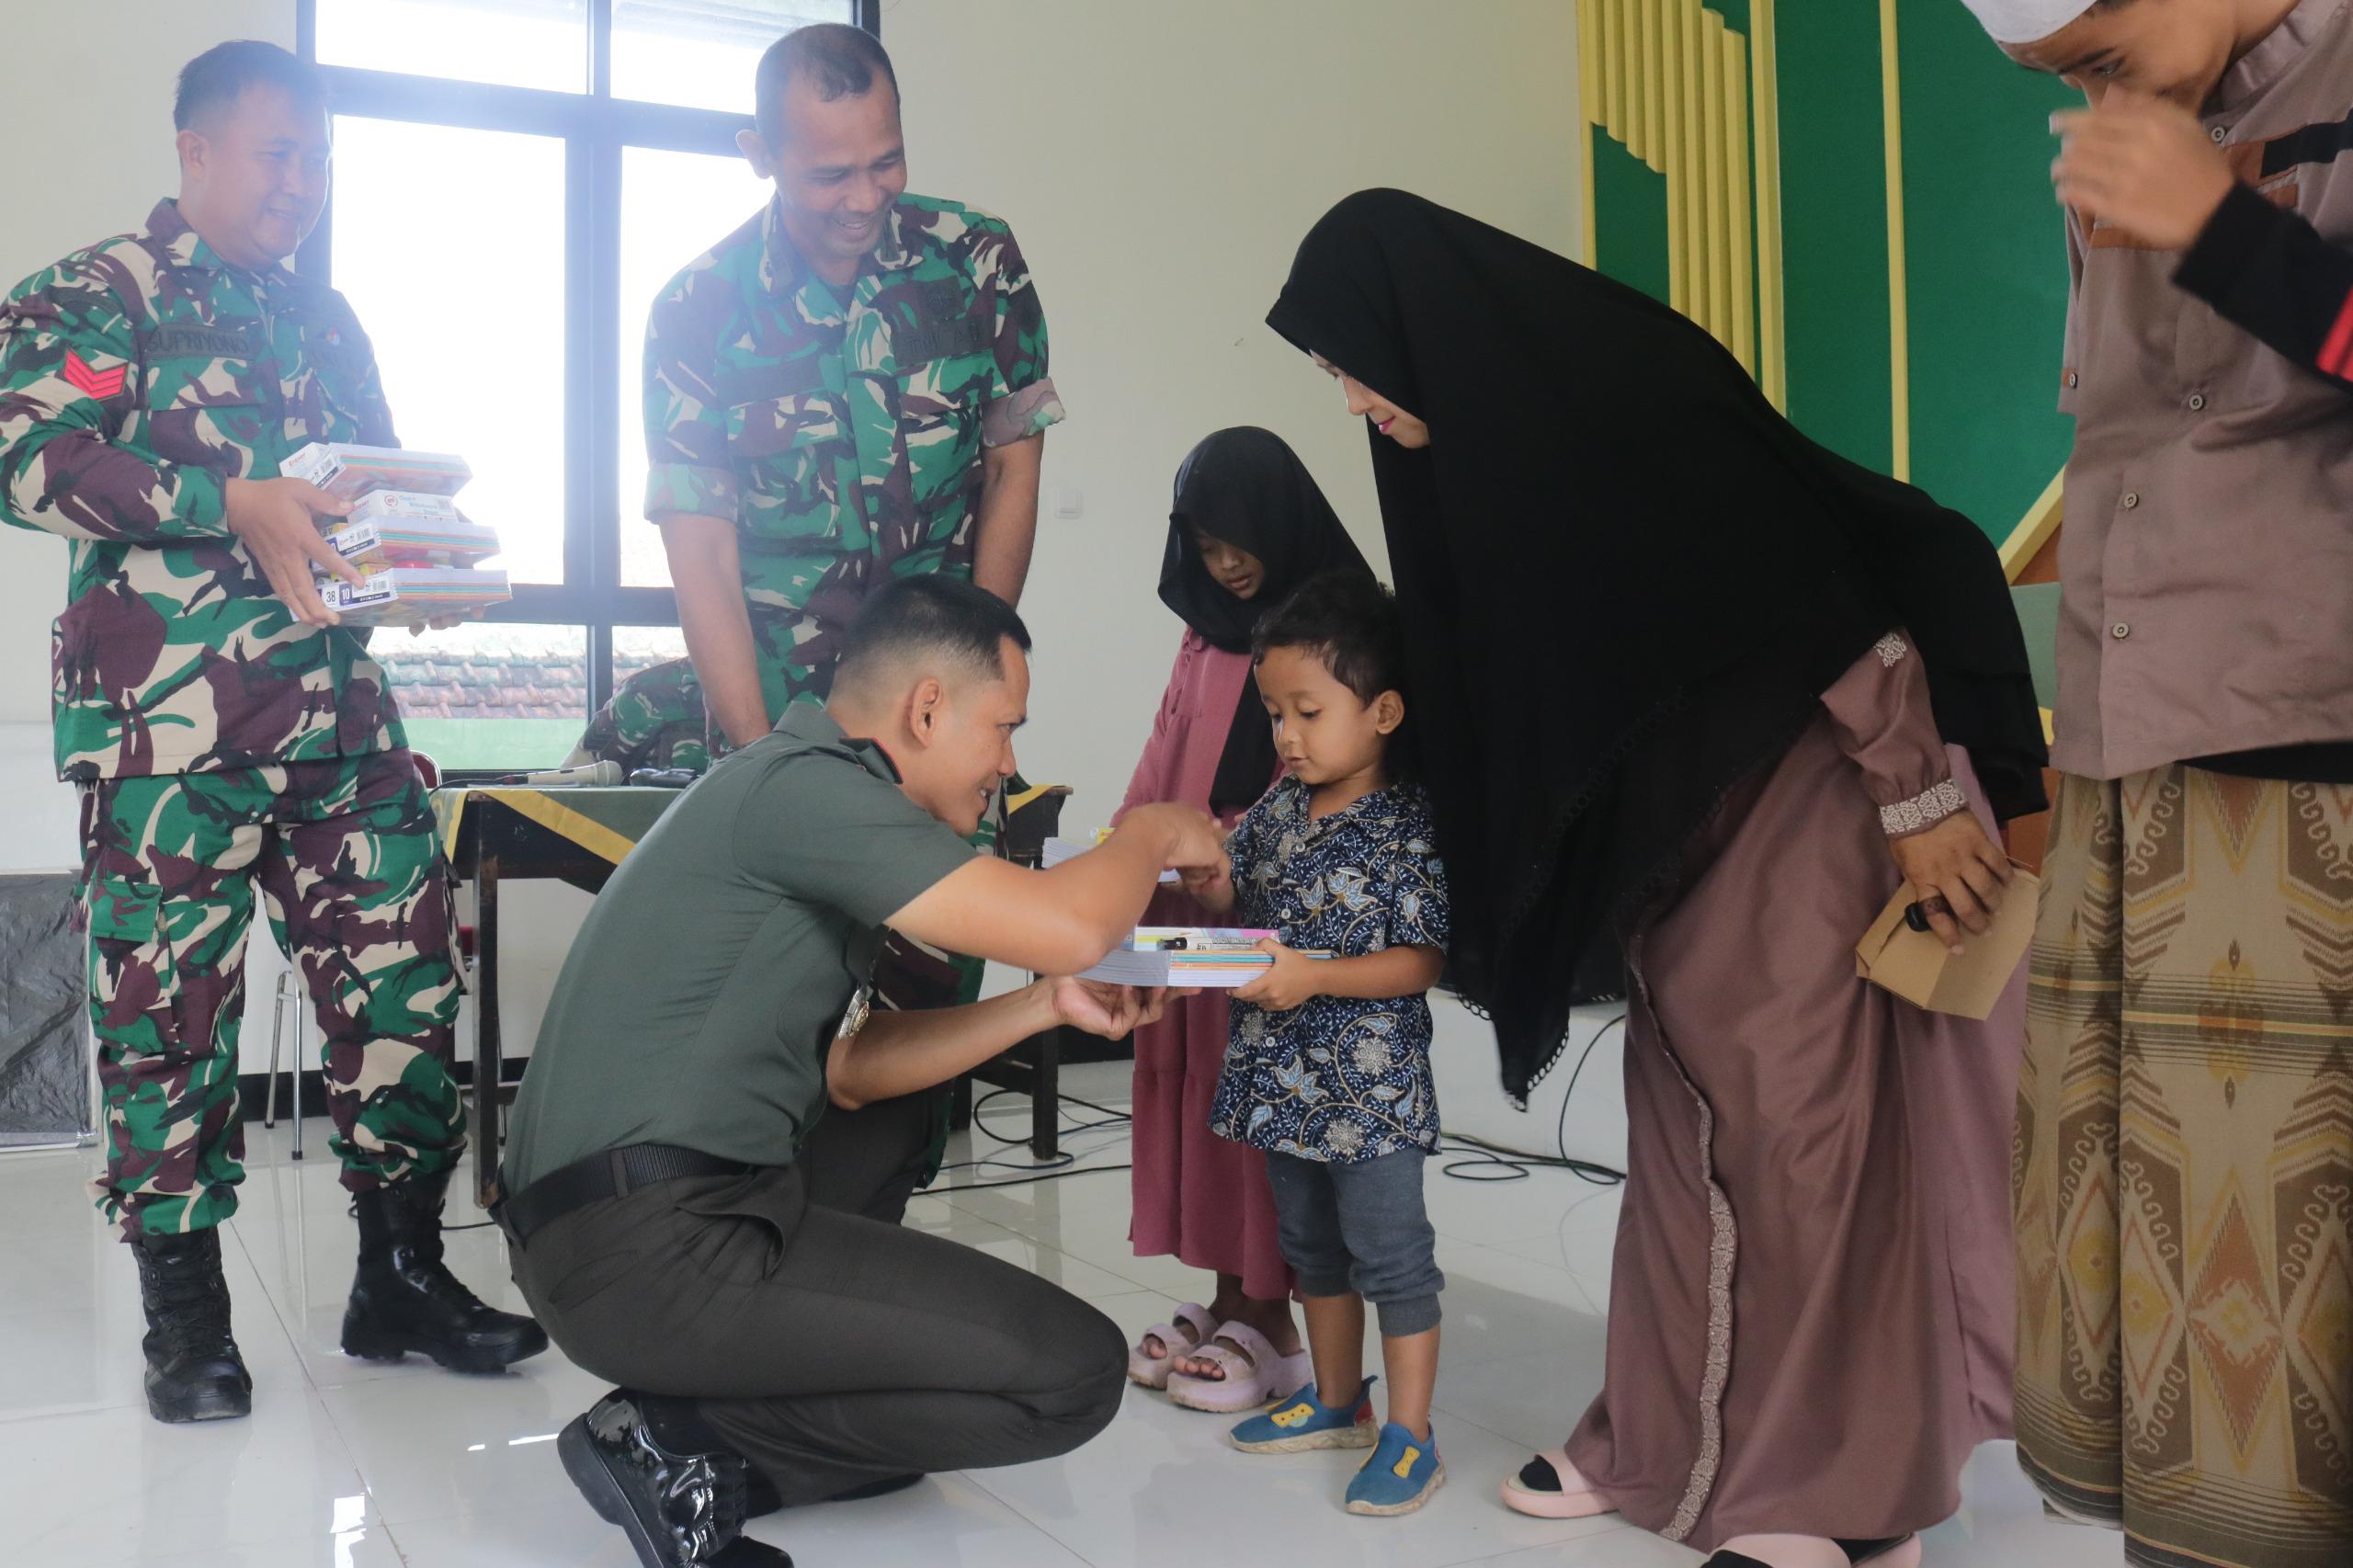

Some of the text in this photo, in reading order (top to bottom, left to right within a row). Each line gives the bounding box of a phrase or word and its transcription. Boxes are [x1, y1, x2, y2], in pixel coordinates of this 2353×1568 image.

[147, 329, 249, 353] SUPRIYONO
[325, 590, 336, 603] 38
[341, 587, 350, 600] 10
